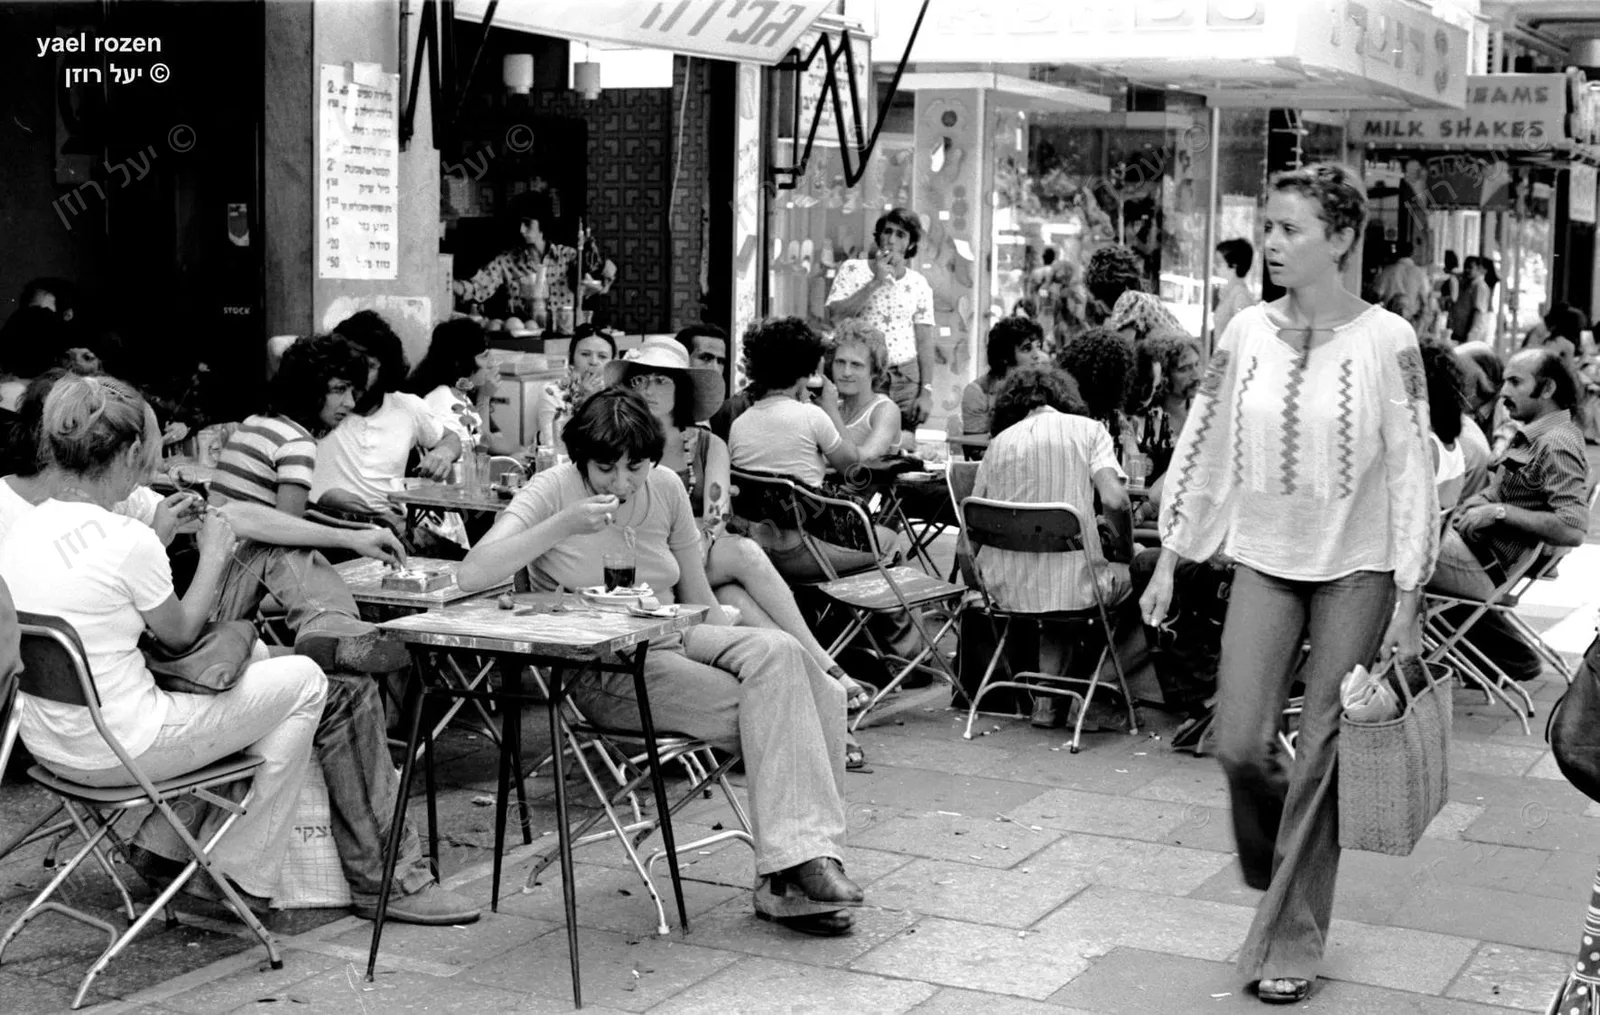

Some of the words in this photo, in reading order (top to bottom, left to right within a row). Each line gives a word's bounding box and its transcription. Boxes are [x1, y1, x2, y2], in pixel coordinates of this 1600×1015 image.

[1363, 119, 1425, 138] MILK
[1439, 117, 1546, 139] SHAKES
[369, 241, 390, 251] סודה
[223, 306, 251, 315] STOCK
[295, 825, 331, 844] צקי
